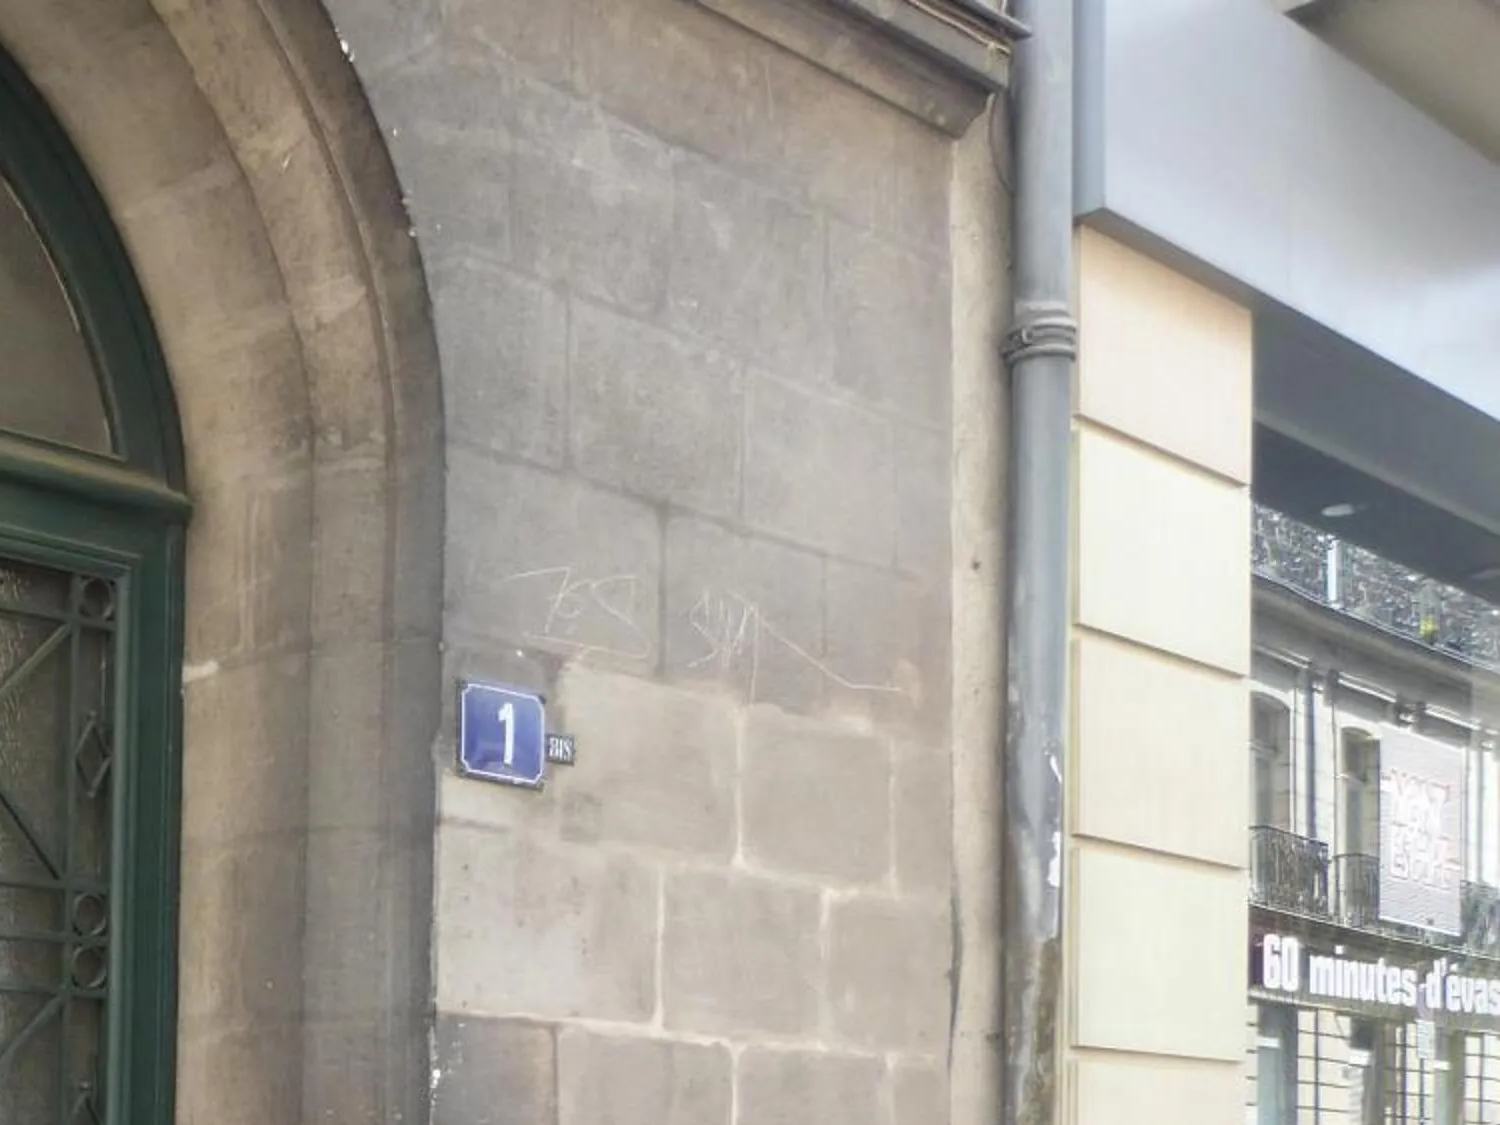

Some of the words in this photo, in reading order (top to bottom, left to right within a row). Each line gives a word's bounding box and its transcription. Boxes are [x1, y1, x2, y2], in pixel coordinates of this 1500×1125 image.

[498, 702, 515, 766] 1
[549, 737, 573, 760] BIS
[1263, 933, 1299, 991] 60
[1309, 944, 1418, 1007] minutes
